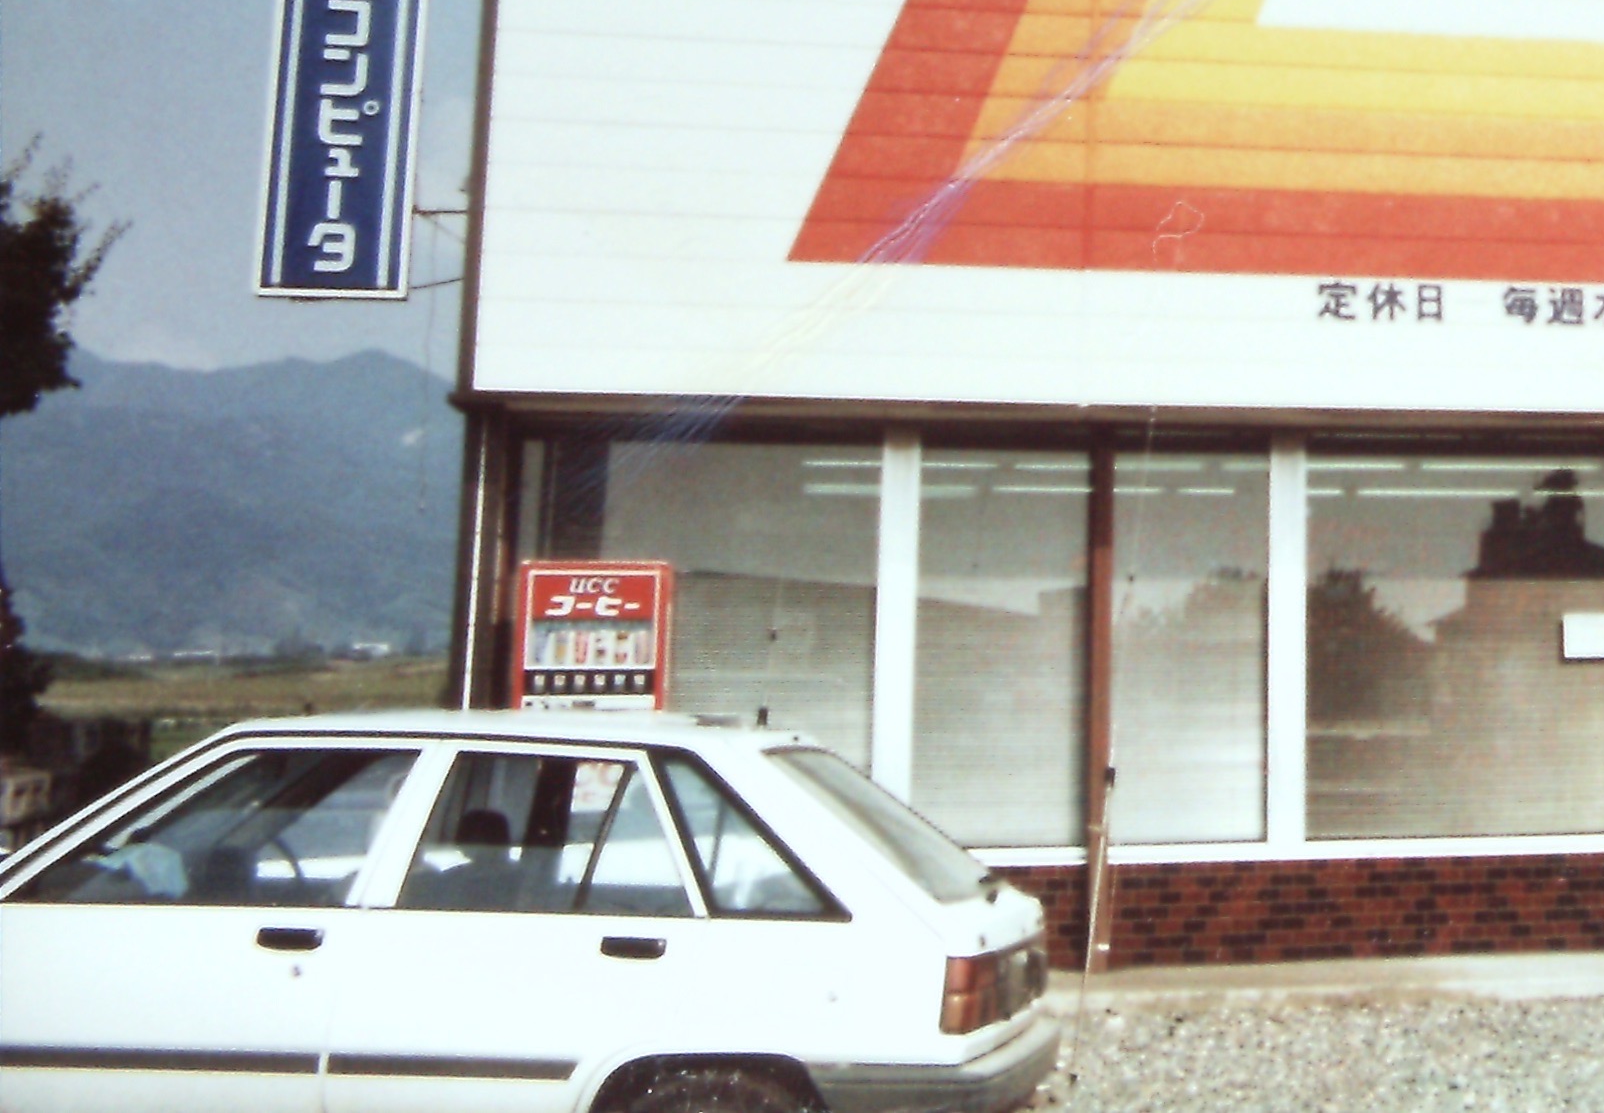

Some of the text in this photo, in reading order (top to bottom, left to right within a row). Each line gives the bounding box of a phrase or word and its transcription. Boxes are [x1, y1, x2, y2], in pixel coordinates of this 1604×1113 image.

[1317, 281, 1444, 321] 定休日
[544, 595, 641, 617] コーヒー
